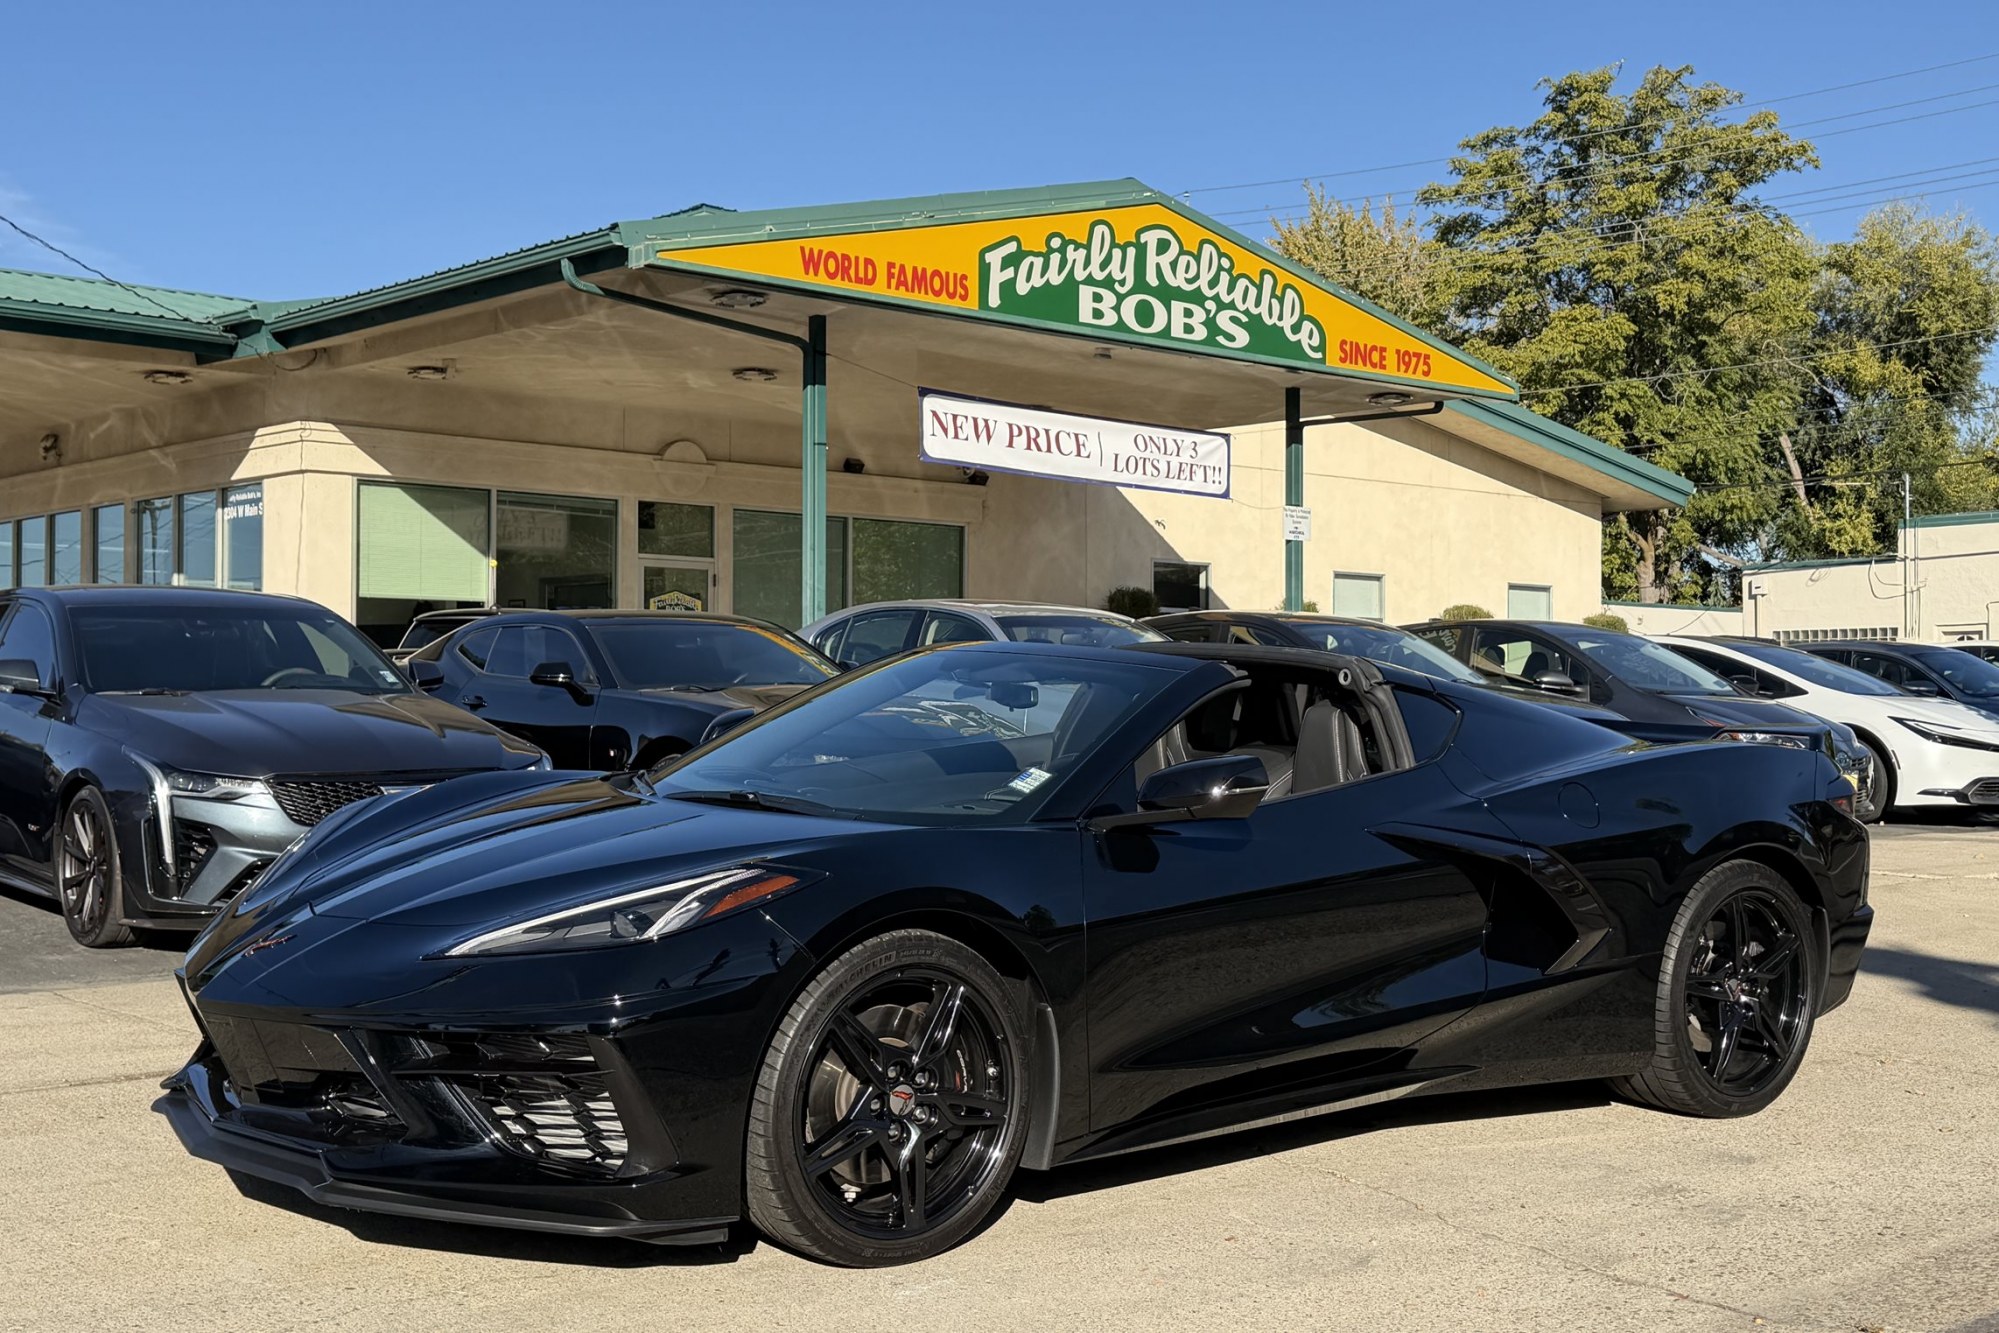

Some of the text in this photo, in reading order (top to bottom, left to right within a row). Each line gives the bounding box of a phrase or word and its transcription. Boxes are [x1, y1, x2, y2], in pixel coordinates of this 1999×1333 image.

[799, 245, 969, 302] WORLD FAMOUS
[984, 224, 1323, 359] Fairly Reliable
[1078, 284, 1250, 349] BOB'S
[1339, 338, 1431, 377] SINCE 1975
[929, 409, 1092, 459] NEW PRICE
[1133, 433, 1199, 459] ONLY 3
[1113, 452, 1222, 485] LOTS LEFT!!
[238, 505, 244, 518] W
[245, 503, 258, 517] Main
